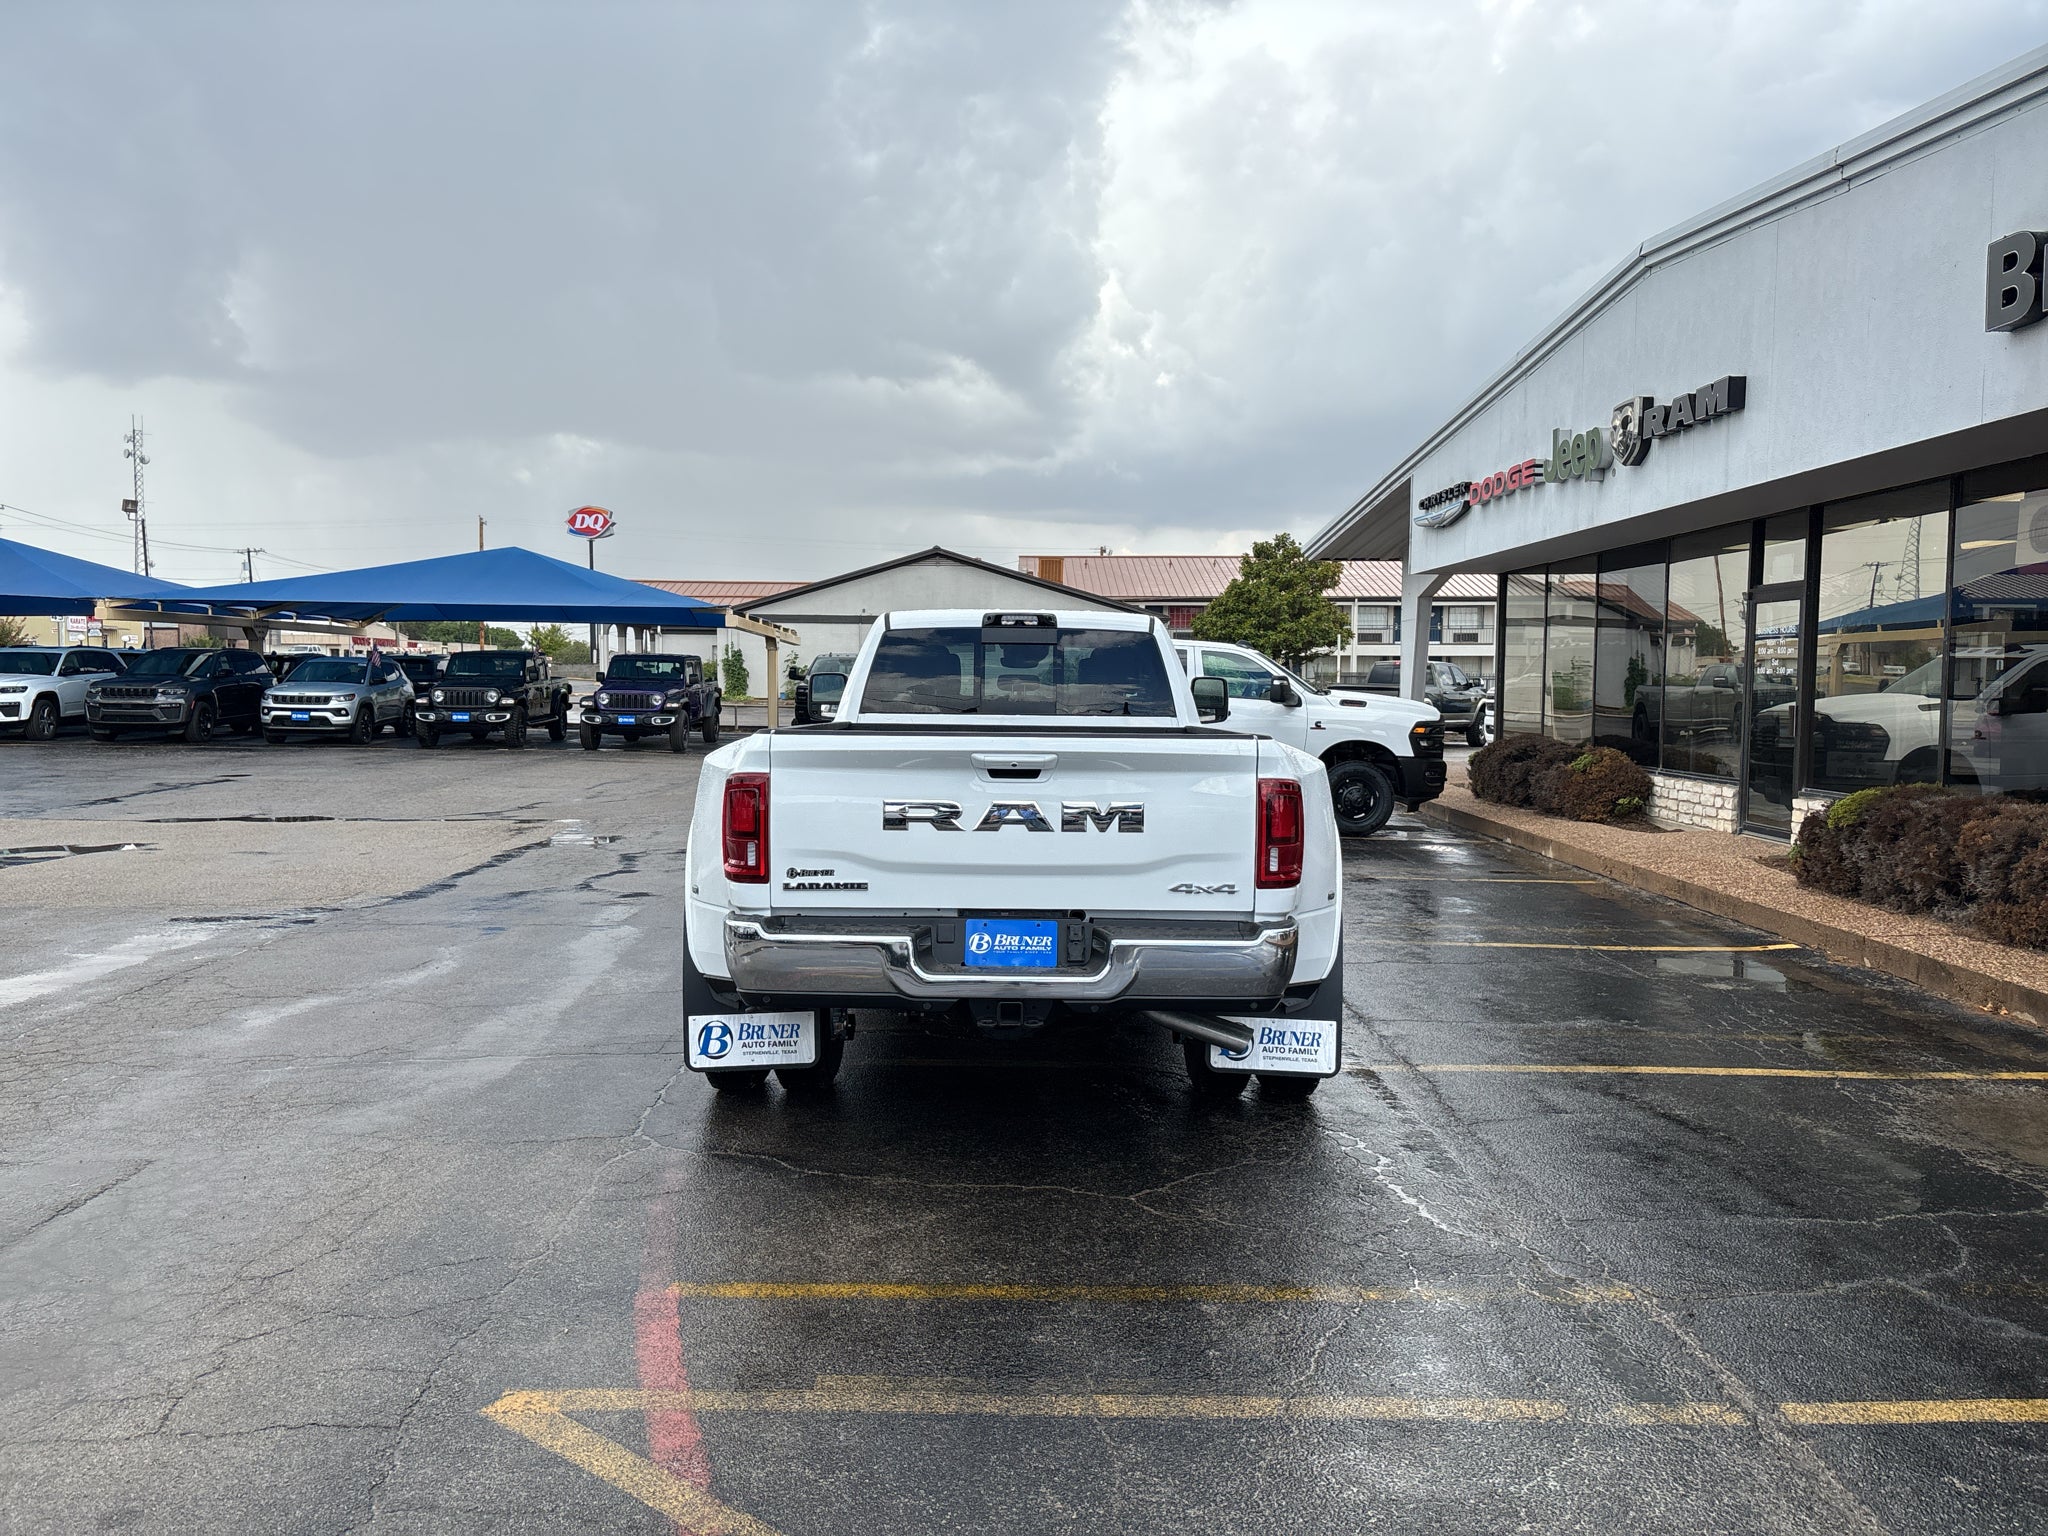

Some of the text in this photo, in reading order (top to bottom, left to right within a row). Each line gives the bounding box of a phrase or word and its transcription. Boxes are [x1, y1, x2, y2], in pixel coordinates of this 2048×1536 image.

[1985, 230, 2048, 332] B
[1643, 376, 1744, 440] RAM
[1543, 426, 1610, 484] Jeep
[1470, 458, 1537, 506] DODGE
[1418, 482, 1471, 510] CHRYSLER
[574, 513, 604, 531] DQ
[1771, 658, 1779, 666] Sat
[882, 799, 1145, 833] RAM
[782, 882, 869, 891] LARAMIE
[1168, 883, 1240, 895] 4x4
[994, 934, 1053, 946] BRUNER
[738, 1023, 801, 1040] BRUNER
[1258, 1027, 1322, 1047] BRUNER
[767, 1039, 798, 1047] FAMILY
[1262, 1046, 1319, 1056] AUTO FAMILY
